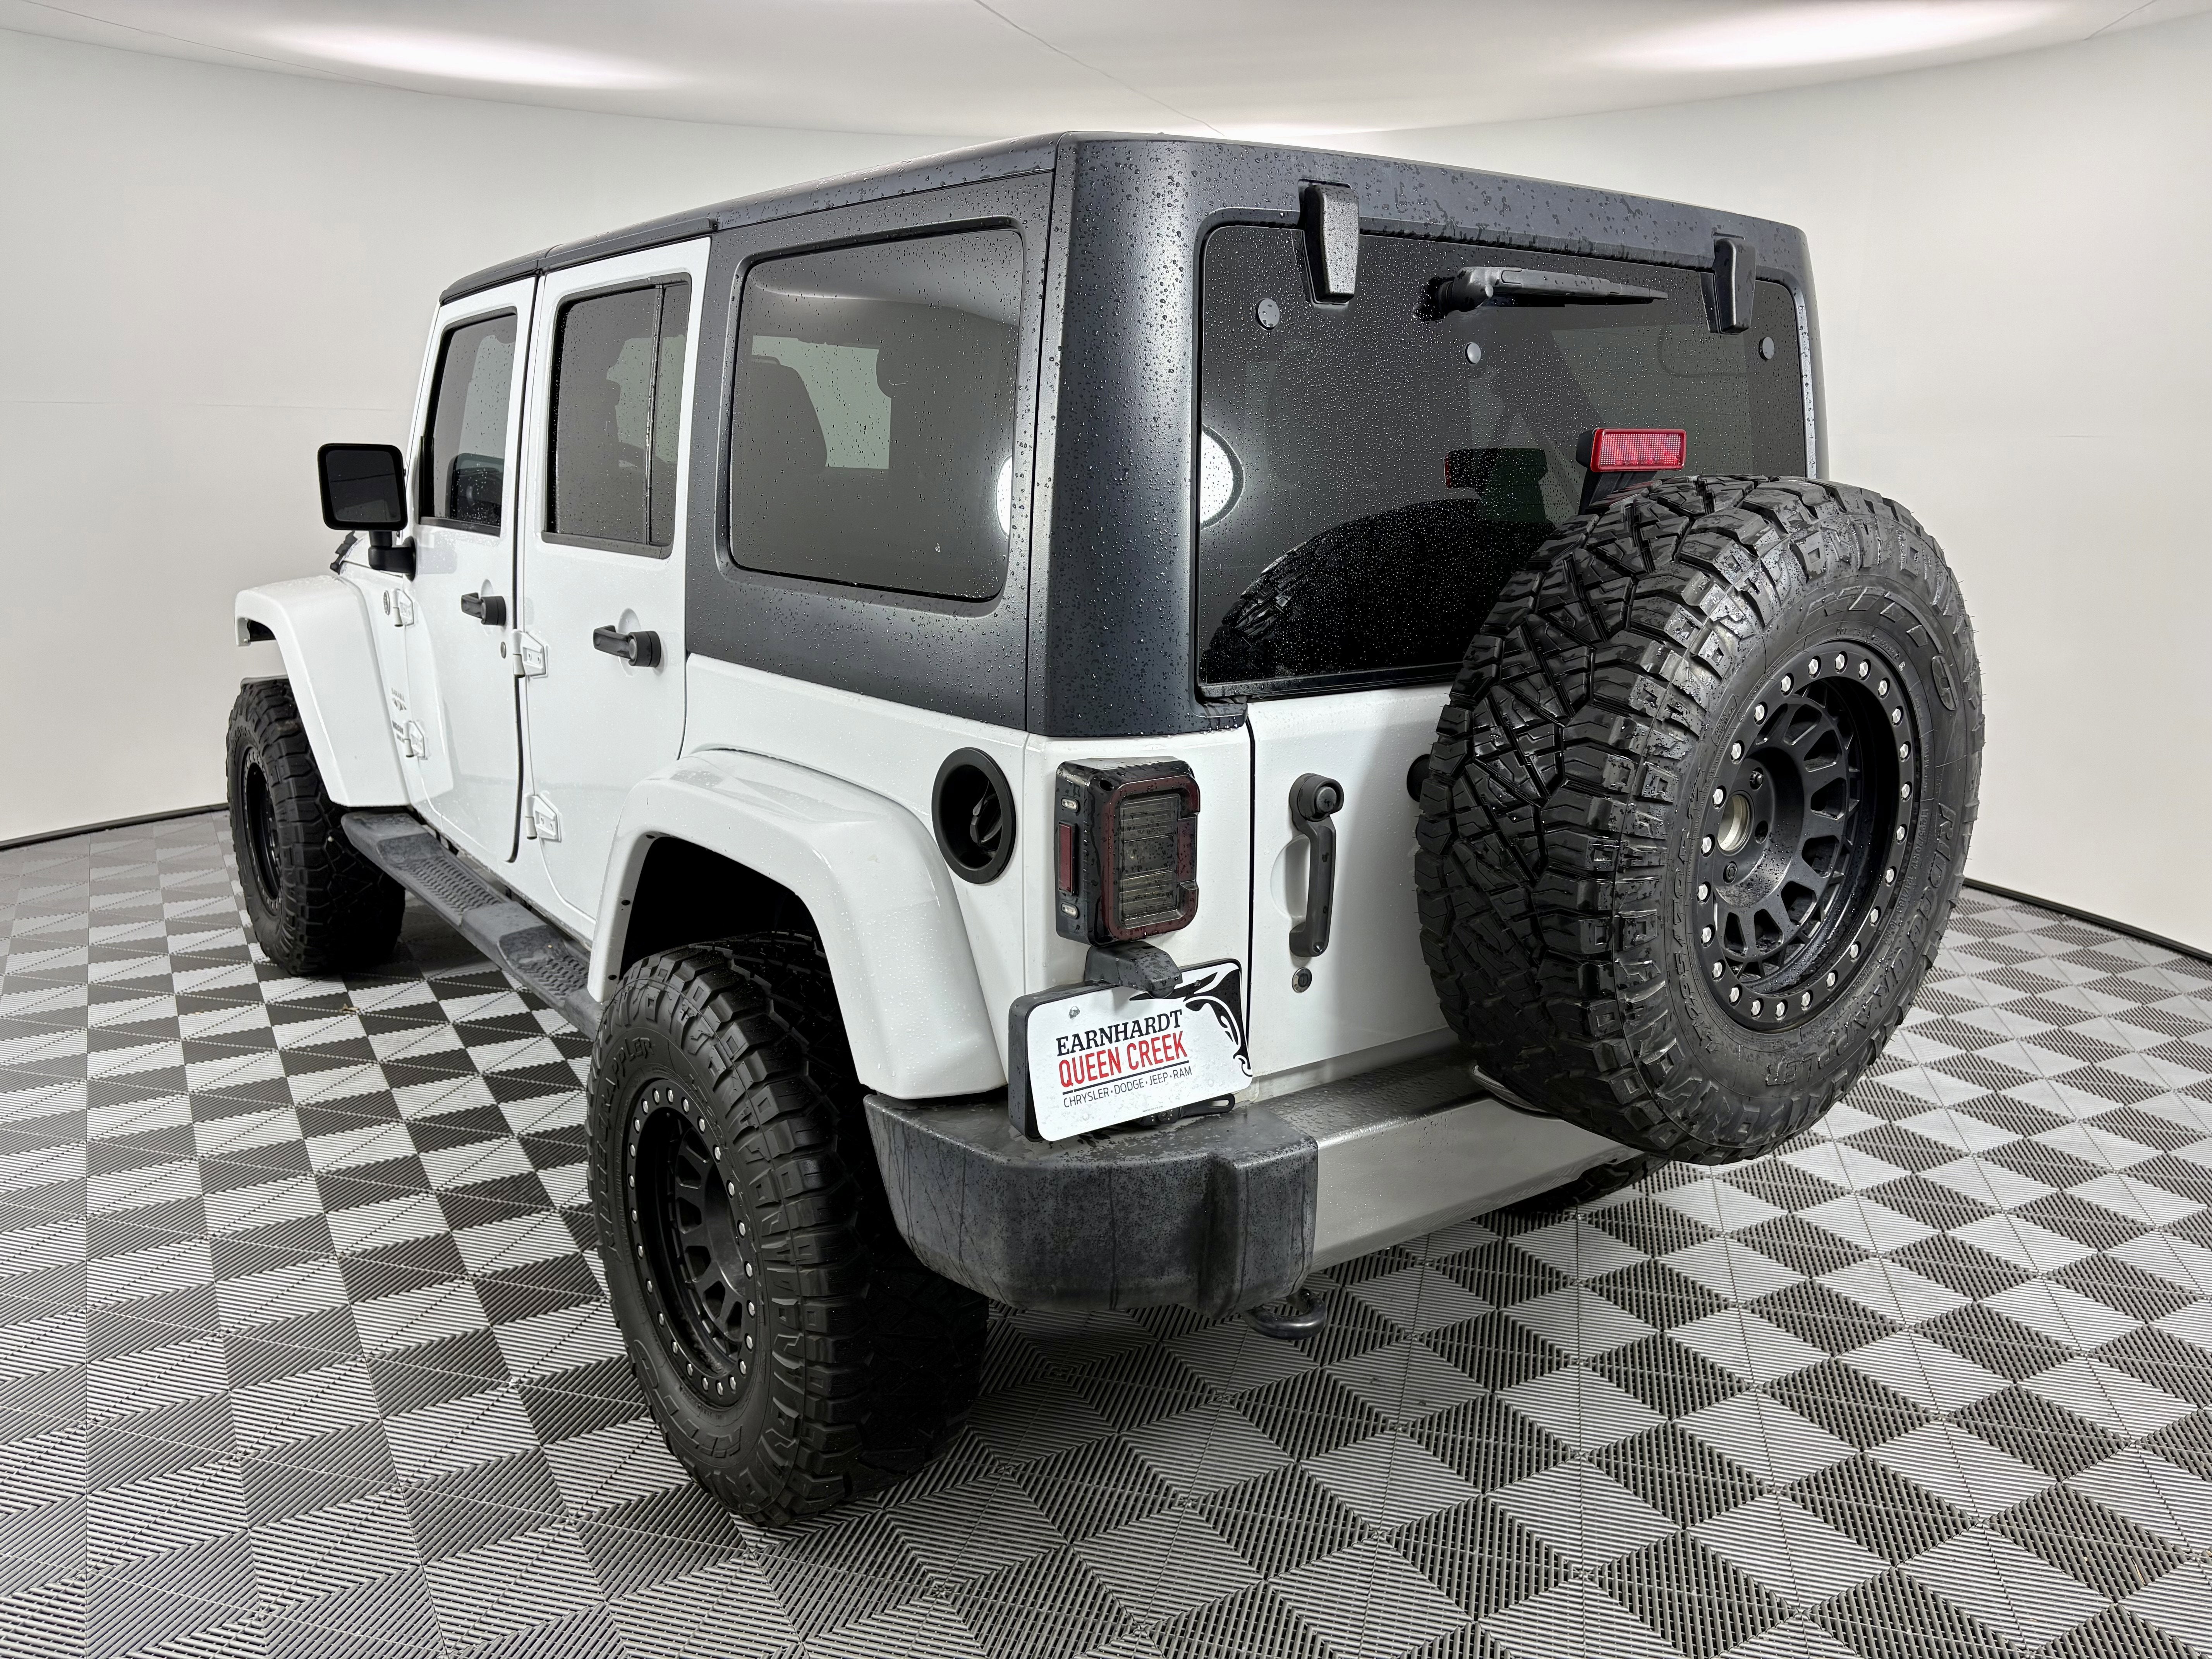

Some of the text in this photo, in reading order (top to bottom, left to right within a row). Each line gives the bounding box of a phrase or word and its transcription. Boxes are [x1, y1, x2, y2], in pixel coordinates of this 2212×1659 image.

[1056, 1009, 1182, 1057] EARNHARDT
[1059, 1031, 1188, 1087] QUEEN CREEK
[1063, 1066, 1192, 1108] CHRYSLER DODGE JEEP RAM
